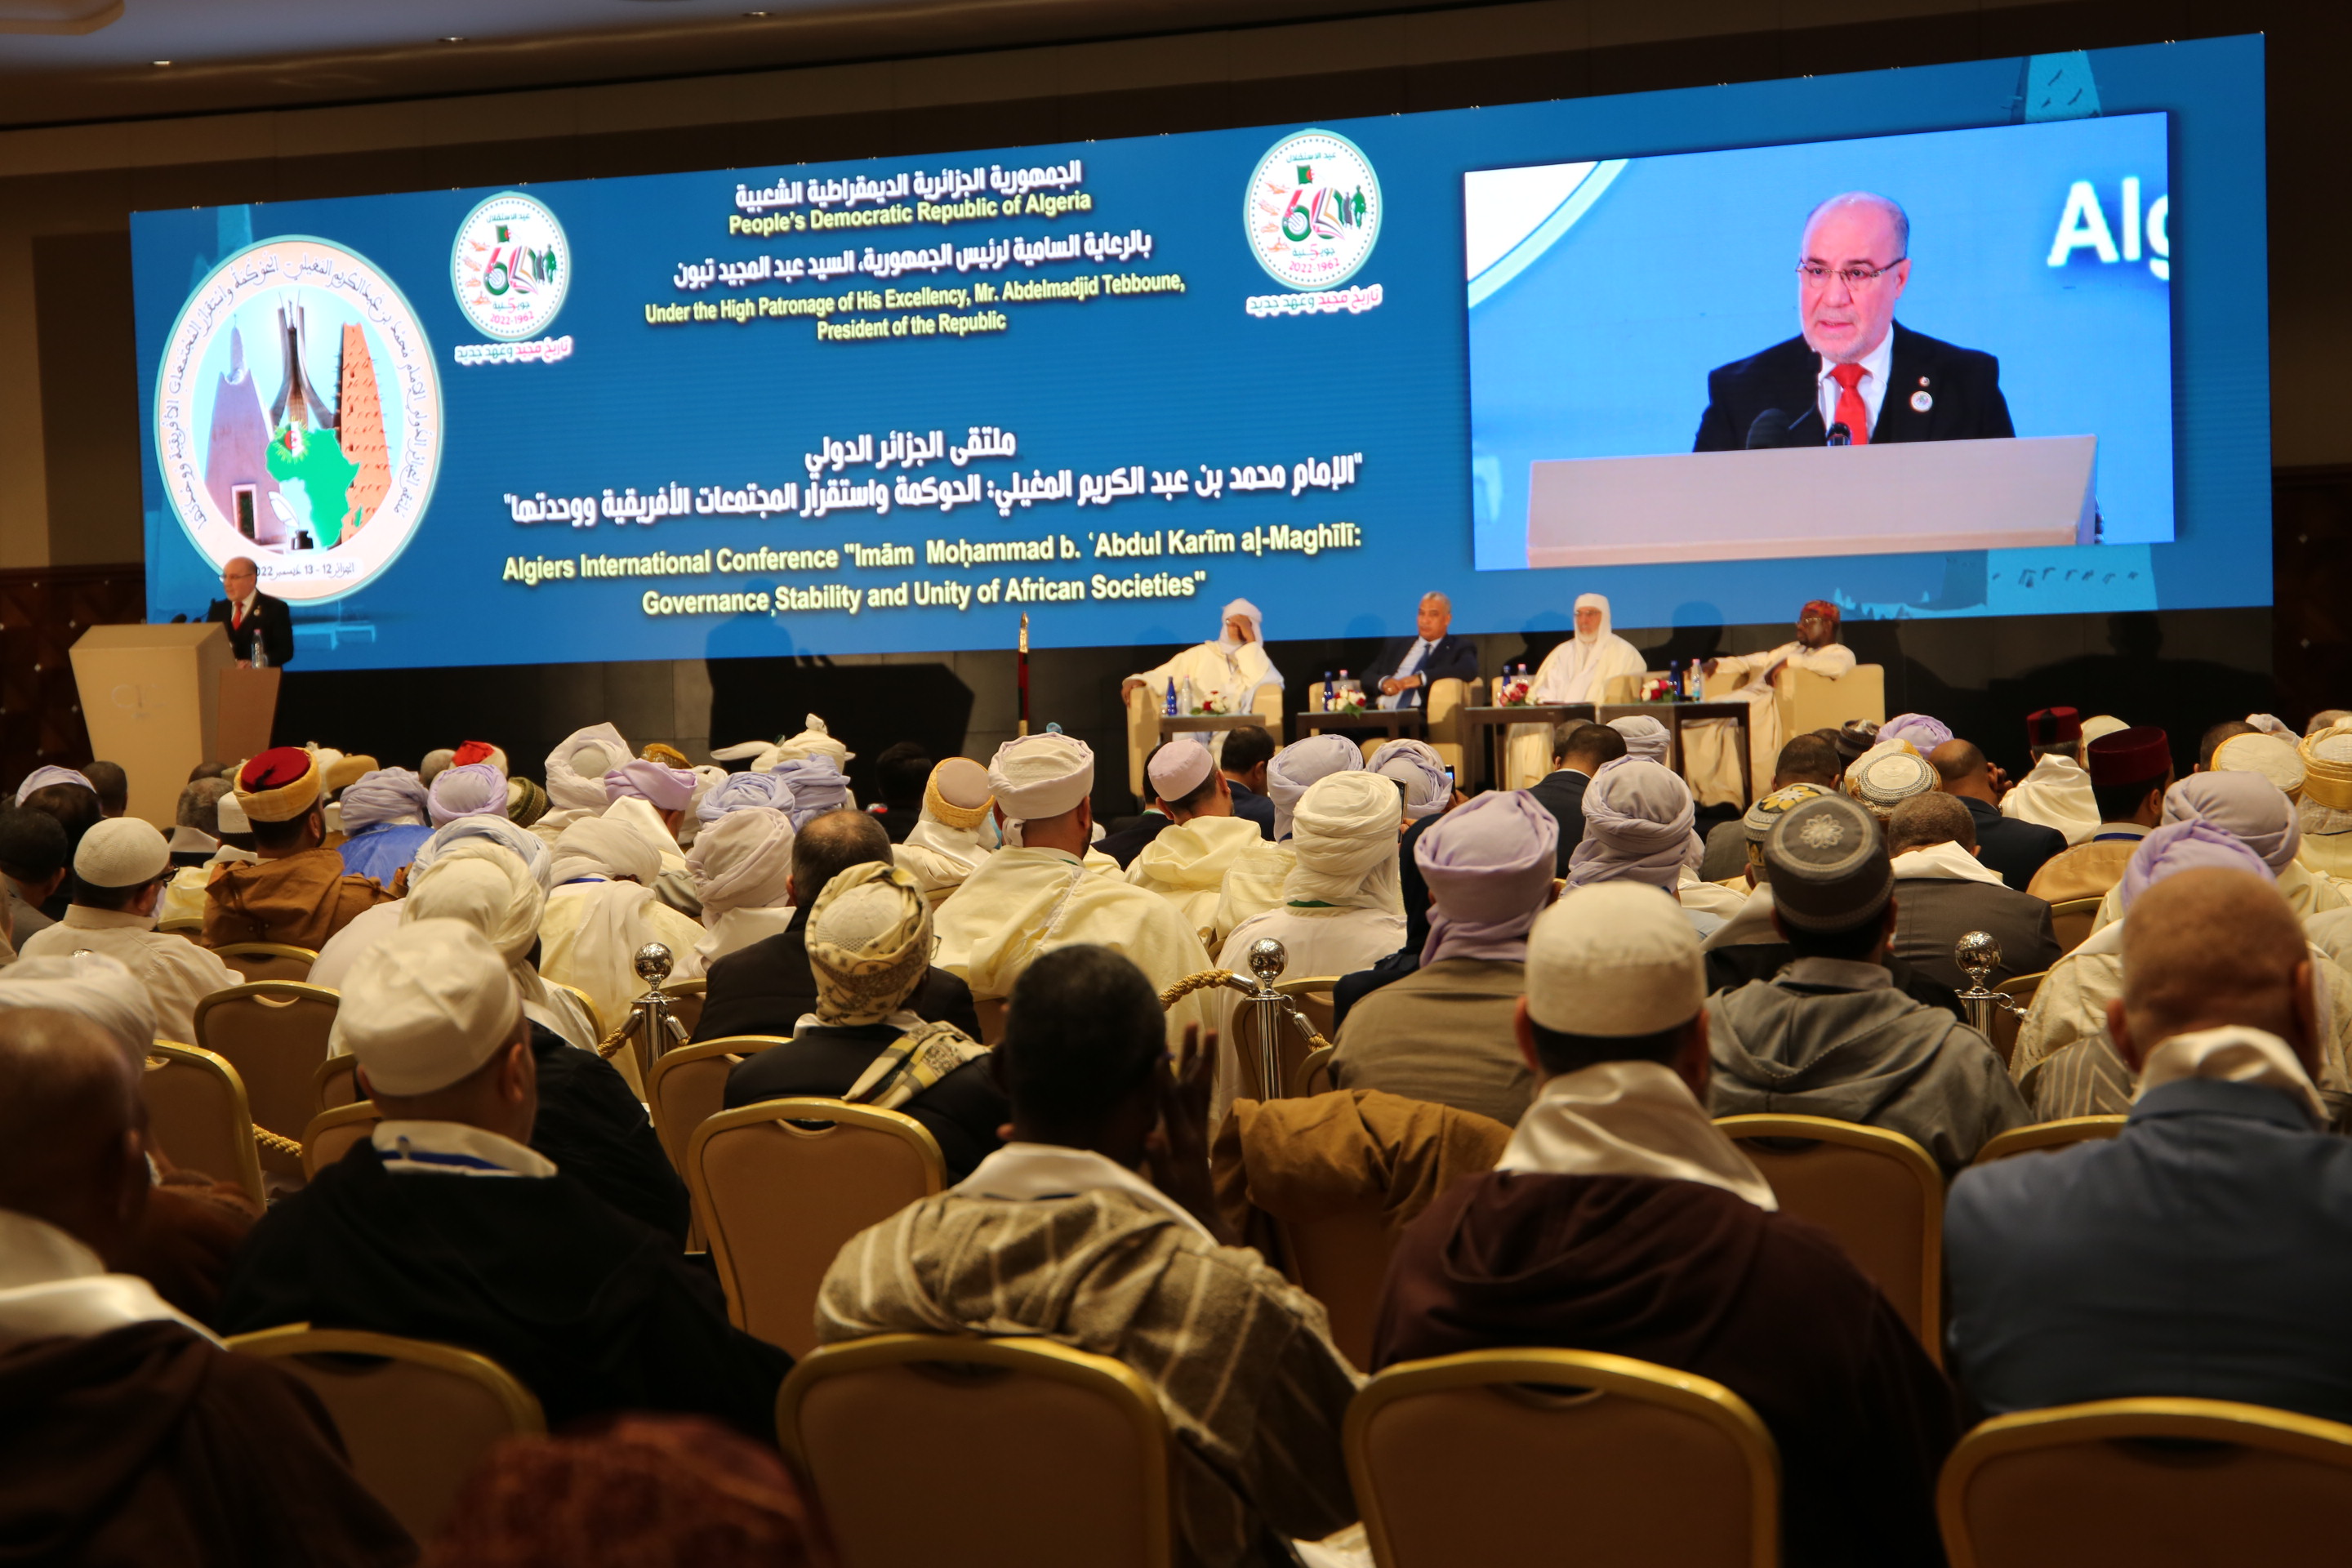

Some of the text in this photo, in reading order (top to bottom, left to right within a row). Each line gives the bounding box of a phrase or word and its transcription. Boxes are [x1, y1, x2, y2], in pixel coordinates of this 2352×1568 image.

[736, 160, 1081, 212] الجمهورية الجزائرية الديمقراطية الشعبية
[811, 203, 913, 229] Democratic
[917, 198, 998, 224] Republic
[1002, 194, 1022, 215] of
[1025, 190, 1091, 217] Algeria
[956, 238, 1009, 270] لرئيس
[1013, 234, 1080, 265] السامية
[1084, 229, 1152, 260] بالرعاية
[674, 258, 715, 287] تبون
[719, 256, 771, 284] المجيد
[774, 258, 804, 281] عبد
[808, 250, 855, 278] السيد
[645, 273, 1185, 323] Under the High Patronage of His Excellency, Mr. Abdelmadjid Tebboune,
[1317, 293, 1348, 309] مجيد
[1351, 287, 1379, 310] تاريخ
[817, 310, 1006, 340] President of the Republic
[514, 344, 542, 358] مجيد
[544, 339, 568, 359] تاريخ
[805, 426, 1016, 480] ملتقى الجزائر الدولي
[894, 474, 981, 511] الحوكمة
[1077, 466, 1144, 506] الكريم
[1151, 470, 1188, 501] عبد
[1195, 465, 1223, 498] بن
[1229, 465, 1285, 490] محمد
[602, 481, 691, 524] الأفريقية
[696, 483, 798, 519] المجتمعات
[800, 479, 889, 518] واستقرار
[256, 566, 274, 577] 022
[305, 564, 314, 574] 13
[323, 564, 332, 573] 12
[503, 555, 576, 585] Algiers
[581, 549, 711, 577] International
[716, 546, 839, 572] Conference
[1060, 535, 1080, 559] b.
[867, 581, 908, 607] and
[914, 581, 971, 610] Unity
[977, 578, 1000, 603] of
[1004, 577, 1085, 602] African
